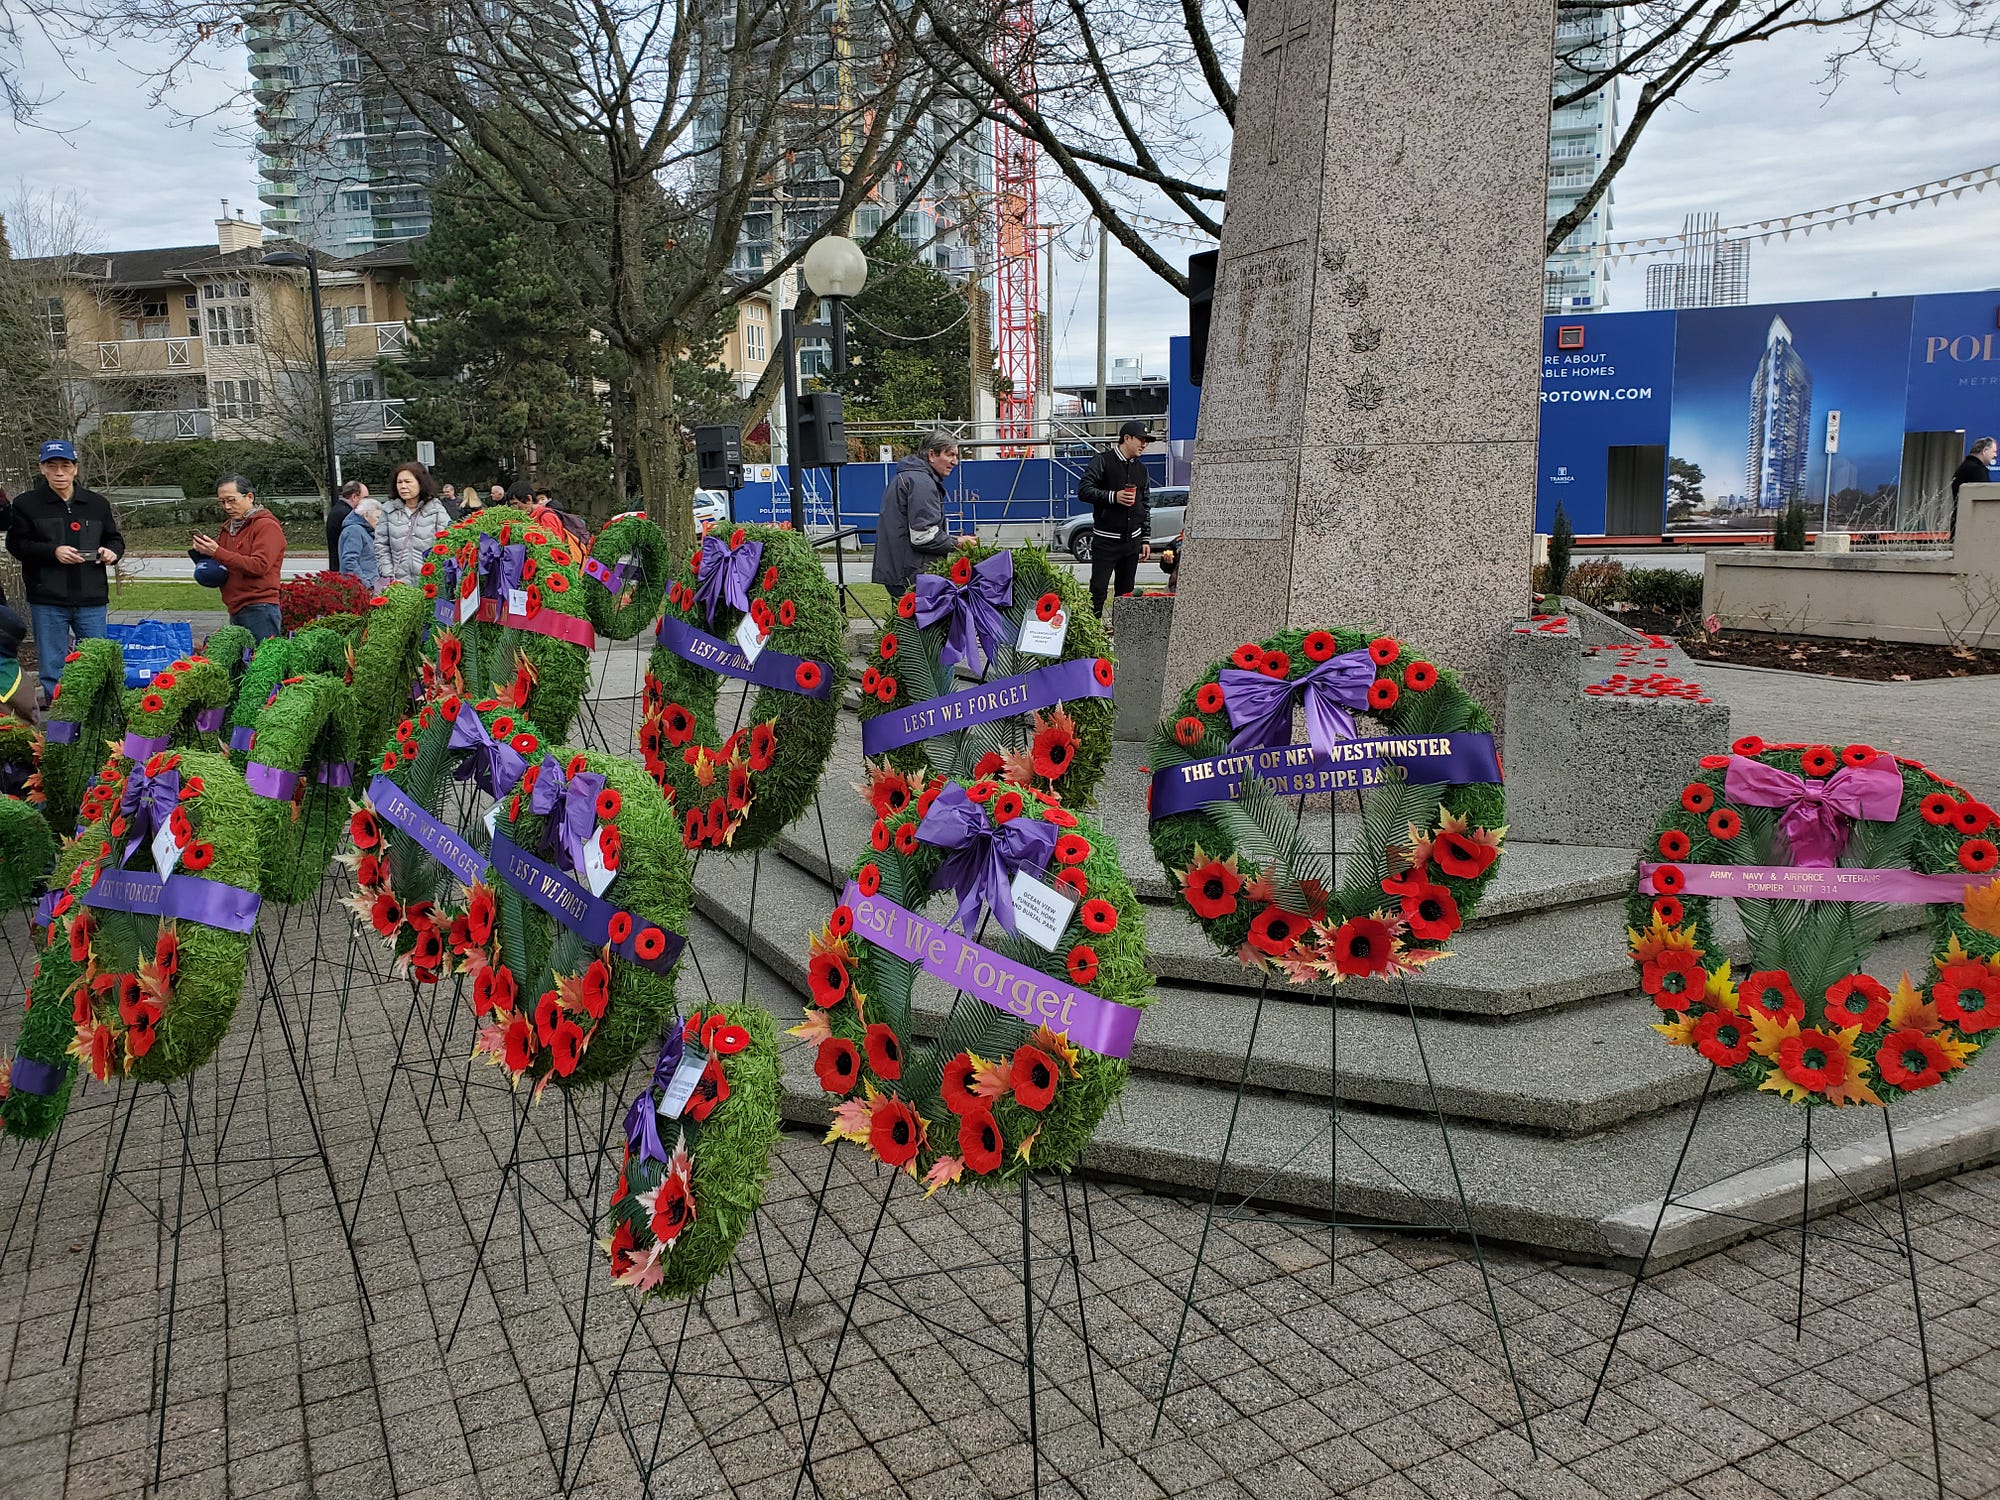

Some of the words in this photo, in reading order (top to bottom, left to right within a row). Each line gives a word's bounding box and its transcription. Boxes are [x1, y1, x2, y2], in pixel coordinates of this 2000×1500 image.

[1563, 353, 1607, 364] ABOUT
[1921, 334, 2000, 364] POL
[1572, 366, 1615, 377] HOMES
[1539, 387, 1652, 403] ROTOWN.COM
[689, 638, 718, 660] LEST
[714, 650, 732, 666] WE
[903, 709, 936, 733] LEST
[941, 702, 963, 722] WE
[968, 684, 1028, 716] FORGET
[1181, 761, 1216, 783] THE
[1217, 754, 1255, 776] CITY
[1259, 751, 1280, 769] OF
[1330, 738, 1452, 763] WESTMINSTER
[1293, 773, 1316, 791] 83
[1318, 769, 1359, 789] PIPE
[388, 797, 417, 827] LEST
[420, 821, 436, 842] WE
[436, 835, 479, 873] FORGET
[508, 854, 540, 886] LEST
[540, 875, 561, 899] WE
[555, 888, 588, 921] FORGET
[1709, 870, 1735, 881] ARMY,
[1742, 872, 1764, 881] NAVY
[1770, 872, 1777, 881] &
[1783, 872, 1825, 882] AIRFORCE
[1836, 874, 1881, 883] VETERANS
[1747, 883, 1784, 892] POMPIER
[1792, 885, 1813, 893] UNIT
[1820, 885, 1838, 894] 314
[124, 882, 163, 904] FORGET
[1023, 891, 1042, 906] OCEAN
[1041, 902, 1057, 914] VIEW
[1016, 896, 1040, 914] FUNERAL
[1040, 910, 1057, 923] HOME
[1022, 908, 1042, 924] BURIAL
[1042, 919, 1057, 932] PARK
[844, 885, 897, 938] Lest
[904, 916, 947, 966] We
[954, 943, 1078, 1026] Forget
